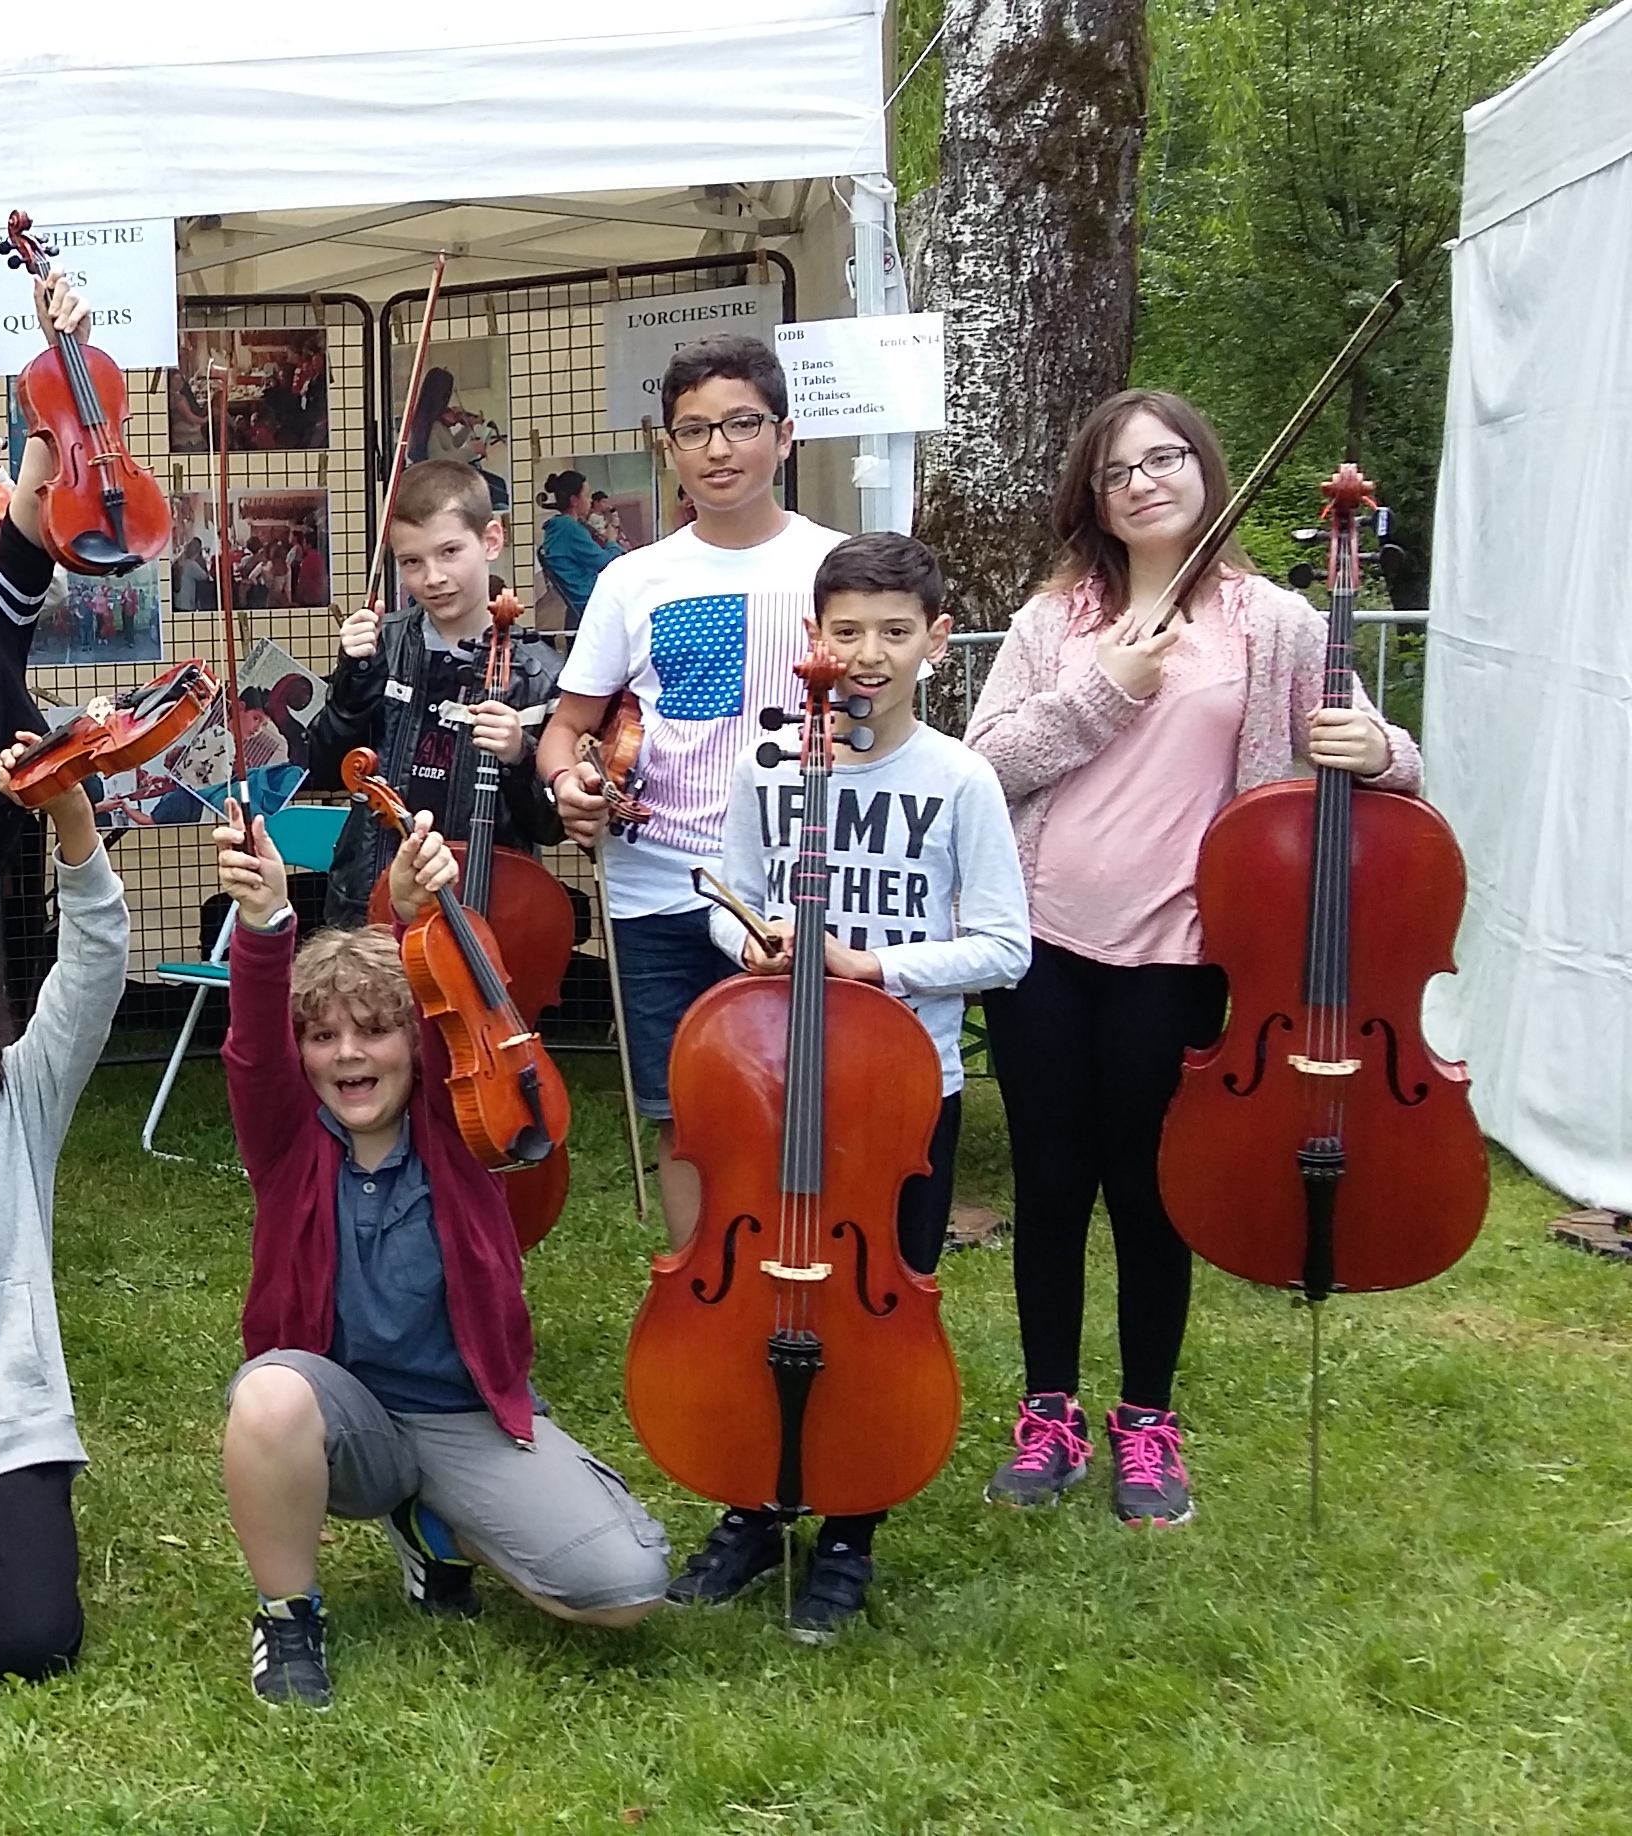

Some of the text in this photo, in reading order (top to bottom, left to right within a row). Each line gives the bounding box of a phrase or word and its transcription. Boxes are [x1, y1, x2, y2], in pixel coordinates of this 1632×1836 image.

[63, 270, 88, 288] ES
[3, 308, 133, 335] QUERS
[627, 301, 758, 329] L'ORCHESTRE
[777, 330, 805, 342] ODB
[792, 359, 835, 371] 2 Bancs
[793, 375, 837, 387] 1 Tables
[794, 390, 851, 403] 14 Chaises
[794, 409, 801, 418] 2
[803, 406, 840, 418] Grilles
[418, 766, 447, 781] CORP.
[833, 788, 944, 860] MY
